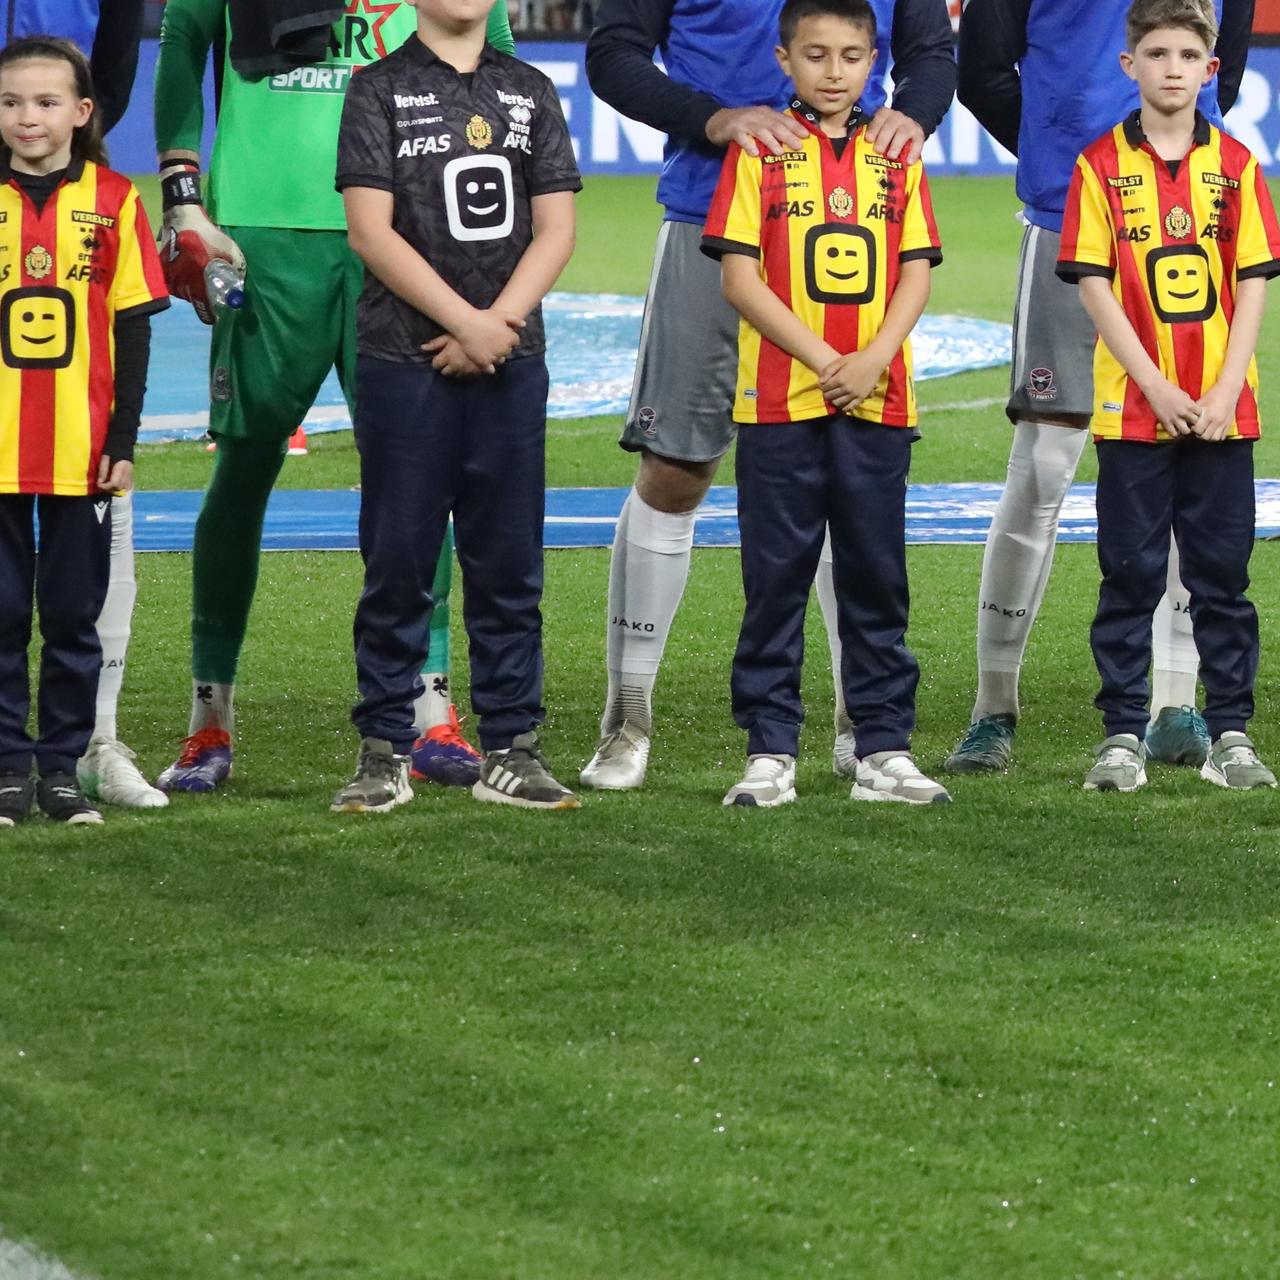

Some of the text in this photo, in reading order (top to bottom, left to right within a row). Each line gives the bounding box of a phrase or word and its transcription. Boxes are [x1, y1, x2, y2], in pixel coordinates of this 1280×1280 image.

[273, 67, 348, 89] SPORT
[397, 134, 452, 158] AFAS
[764, 153, 806, 164] VERELST
[866, 156, 903, 169] VERELST
[1204, 174, 1239, 188] VERELST
[766, 201, 814, 221] AFAS
[866, 203, 905, 224] AFAS
[982, 601, 1026, 618] JAKO
[612, 616, 655, 632] JAKO
